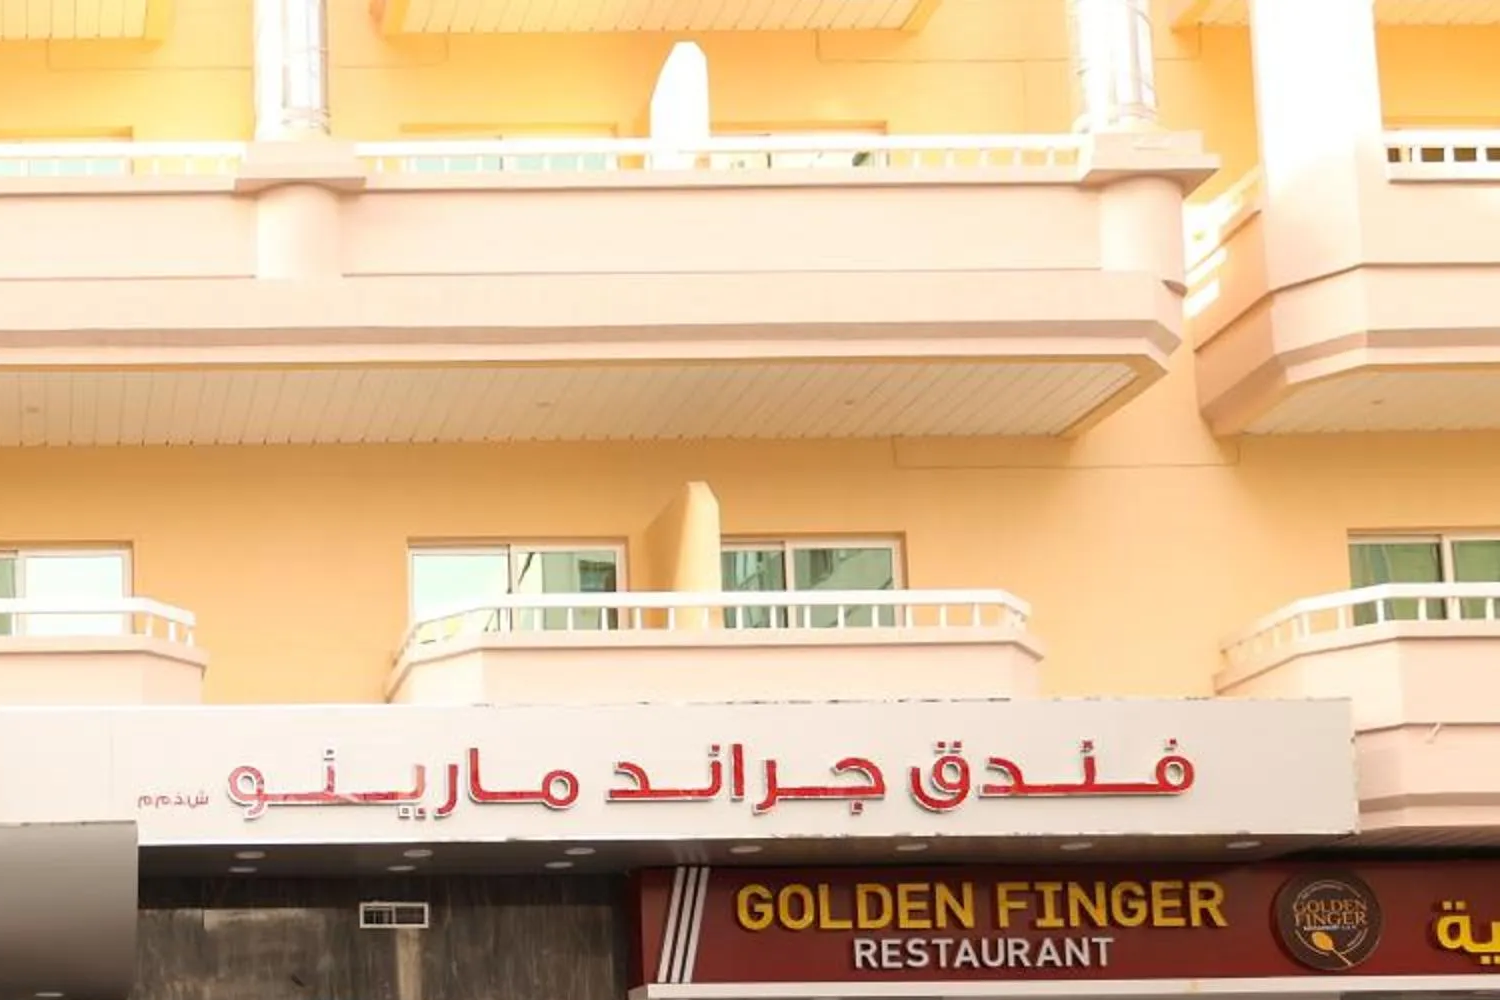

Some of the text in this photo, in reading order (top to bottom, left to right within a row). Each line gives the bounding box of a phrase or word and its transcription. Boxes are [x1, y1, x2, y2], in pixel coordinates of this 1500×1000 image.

[227, 746, 580, 820] مارينو
[605, 743, 887, 815] جراند
[909, 739, 1196, 812] فندق
[735, 880, 1229, 931] GOLDEN FINGER
[1293, 899, 1368, 914] GOLDEN
[1294, 911, 1369, 928] FINGER
[853, 936, 1115, 969] RESTAURANT
